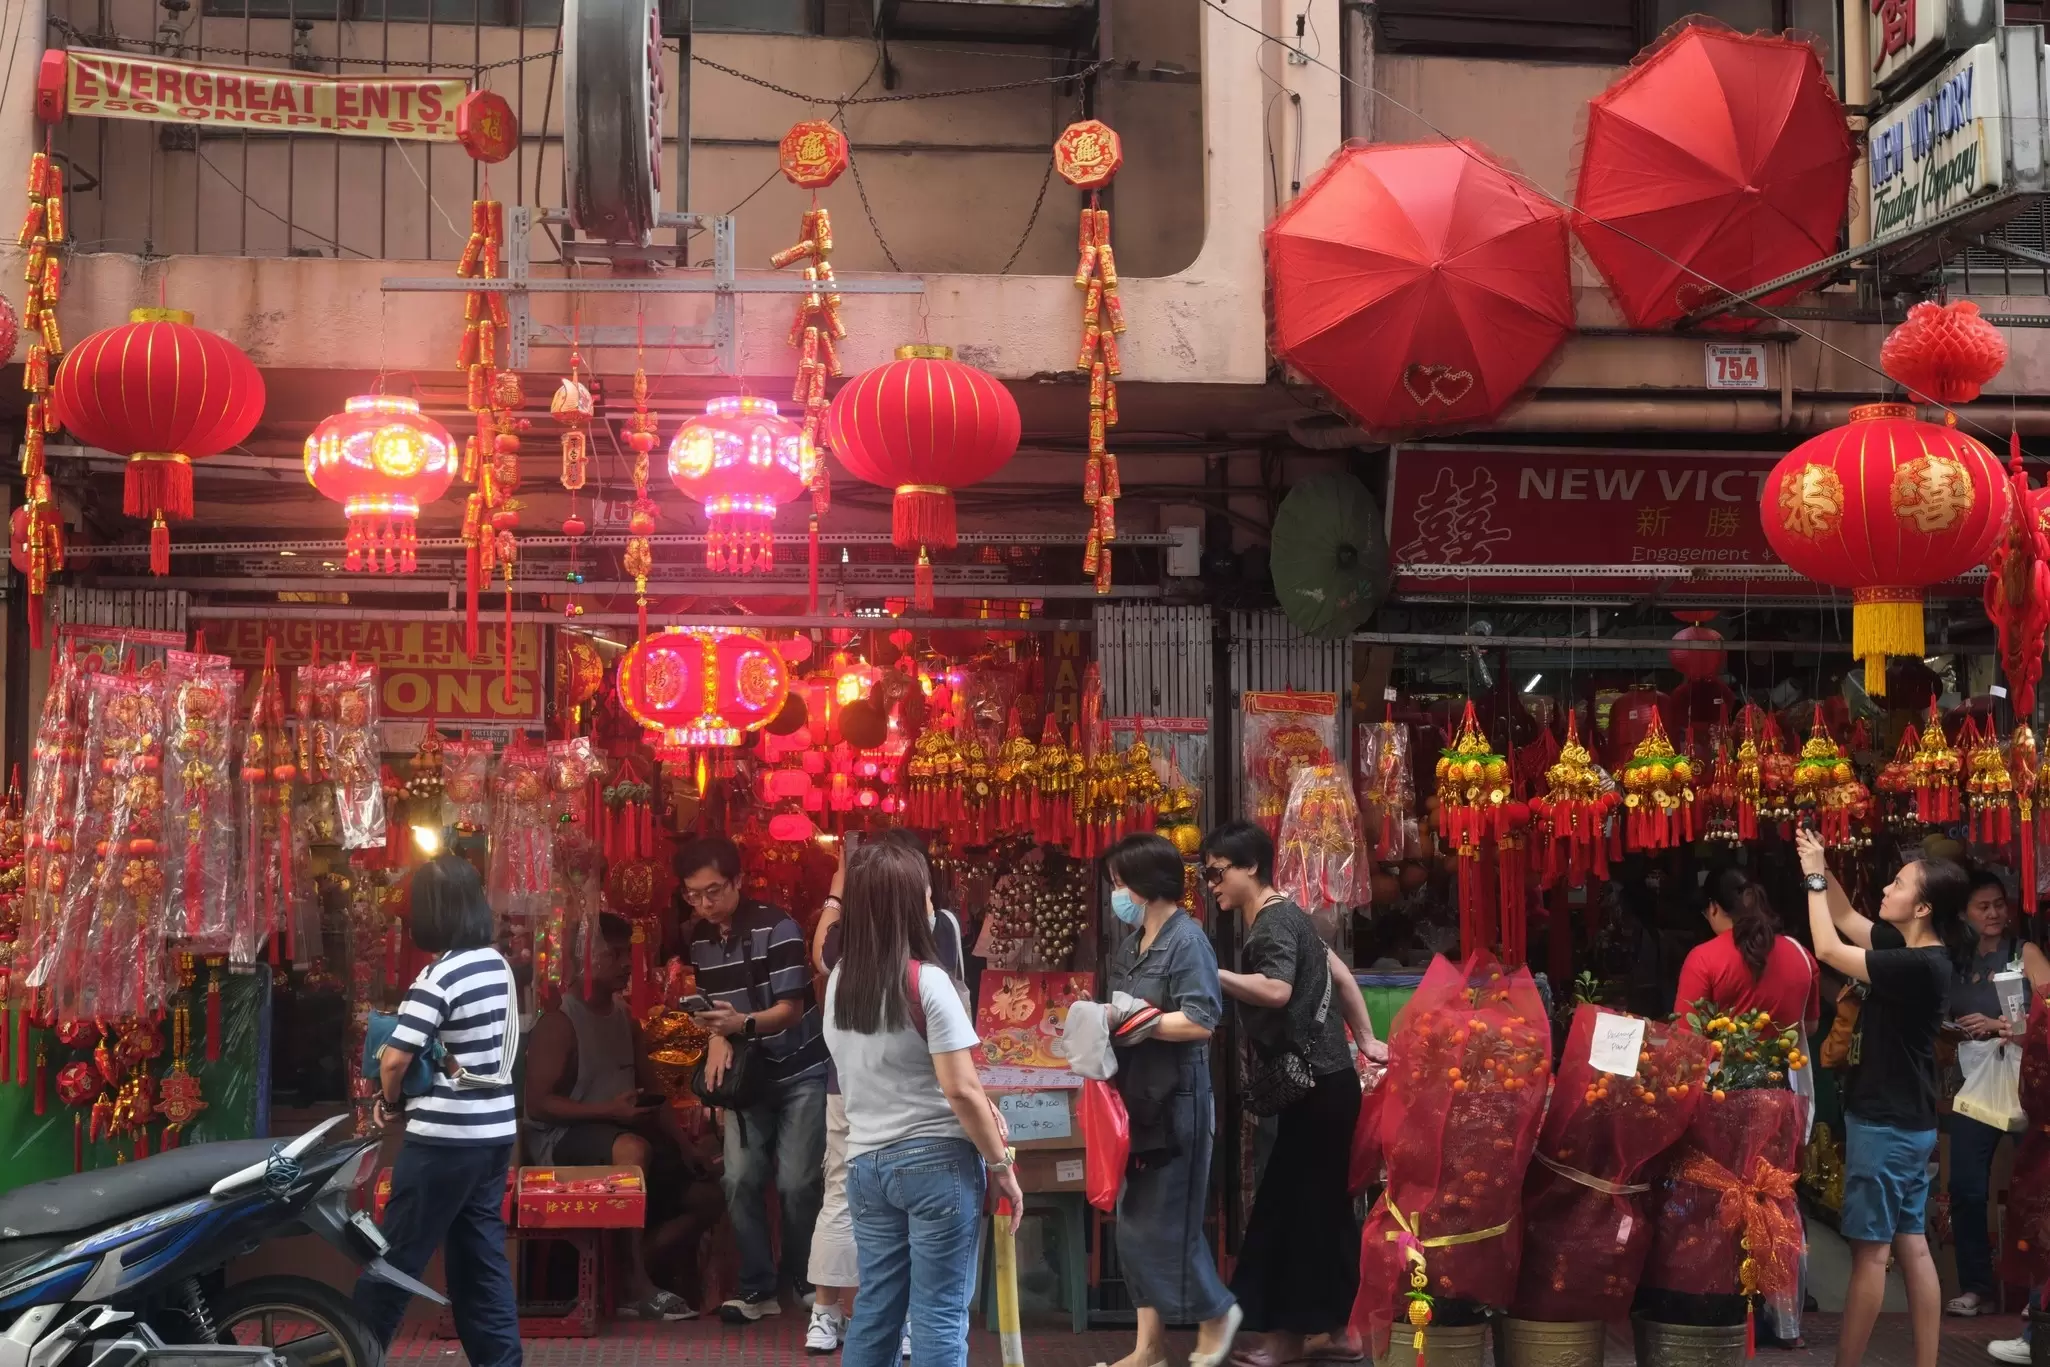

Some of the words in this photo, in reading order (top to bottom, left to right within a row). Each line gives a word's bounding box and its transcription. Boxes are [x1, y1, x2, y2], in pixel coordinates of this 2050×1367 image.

[75, 60, 320, 113] EVERGREAT
[336, 82, 454, 122] ENTS.
[75, 98, 159, 113] 756
[178, 107, 367, 131] ONGPIN
[1872, 122, 1904, 189] NEW
[1908, 66, 1973, 162] VICTORY
[1874, 182, 1920, 238] Trading
[1922, 141, 1978, 208] Company
[1715, 356, 1759, 381] 754
[1518, 467, 1645, 500] NEW
[1657, 469, 1767, 501] VICT
[1631, 546, 1751, 563] Engagement
[1003, 1100, 1009, 1111] 3
[546, 1200, 599, 1213] 大吉大利
